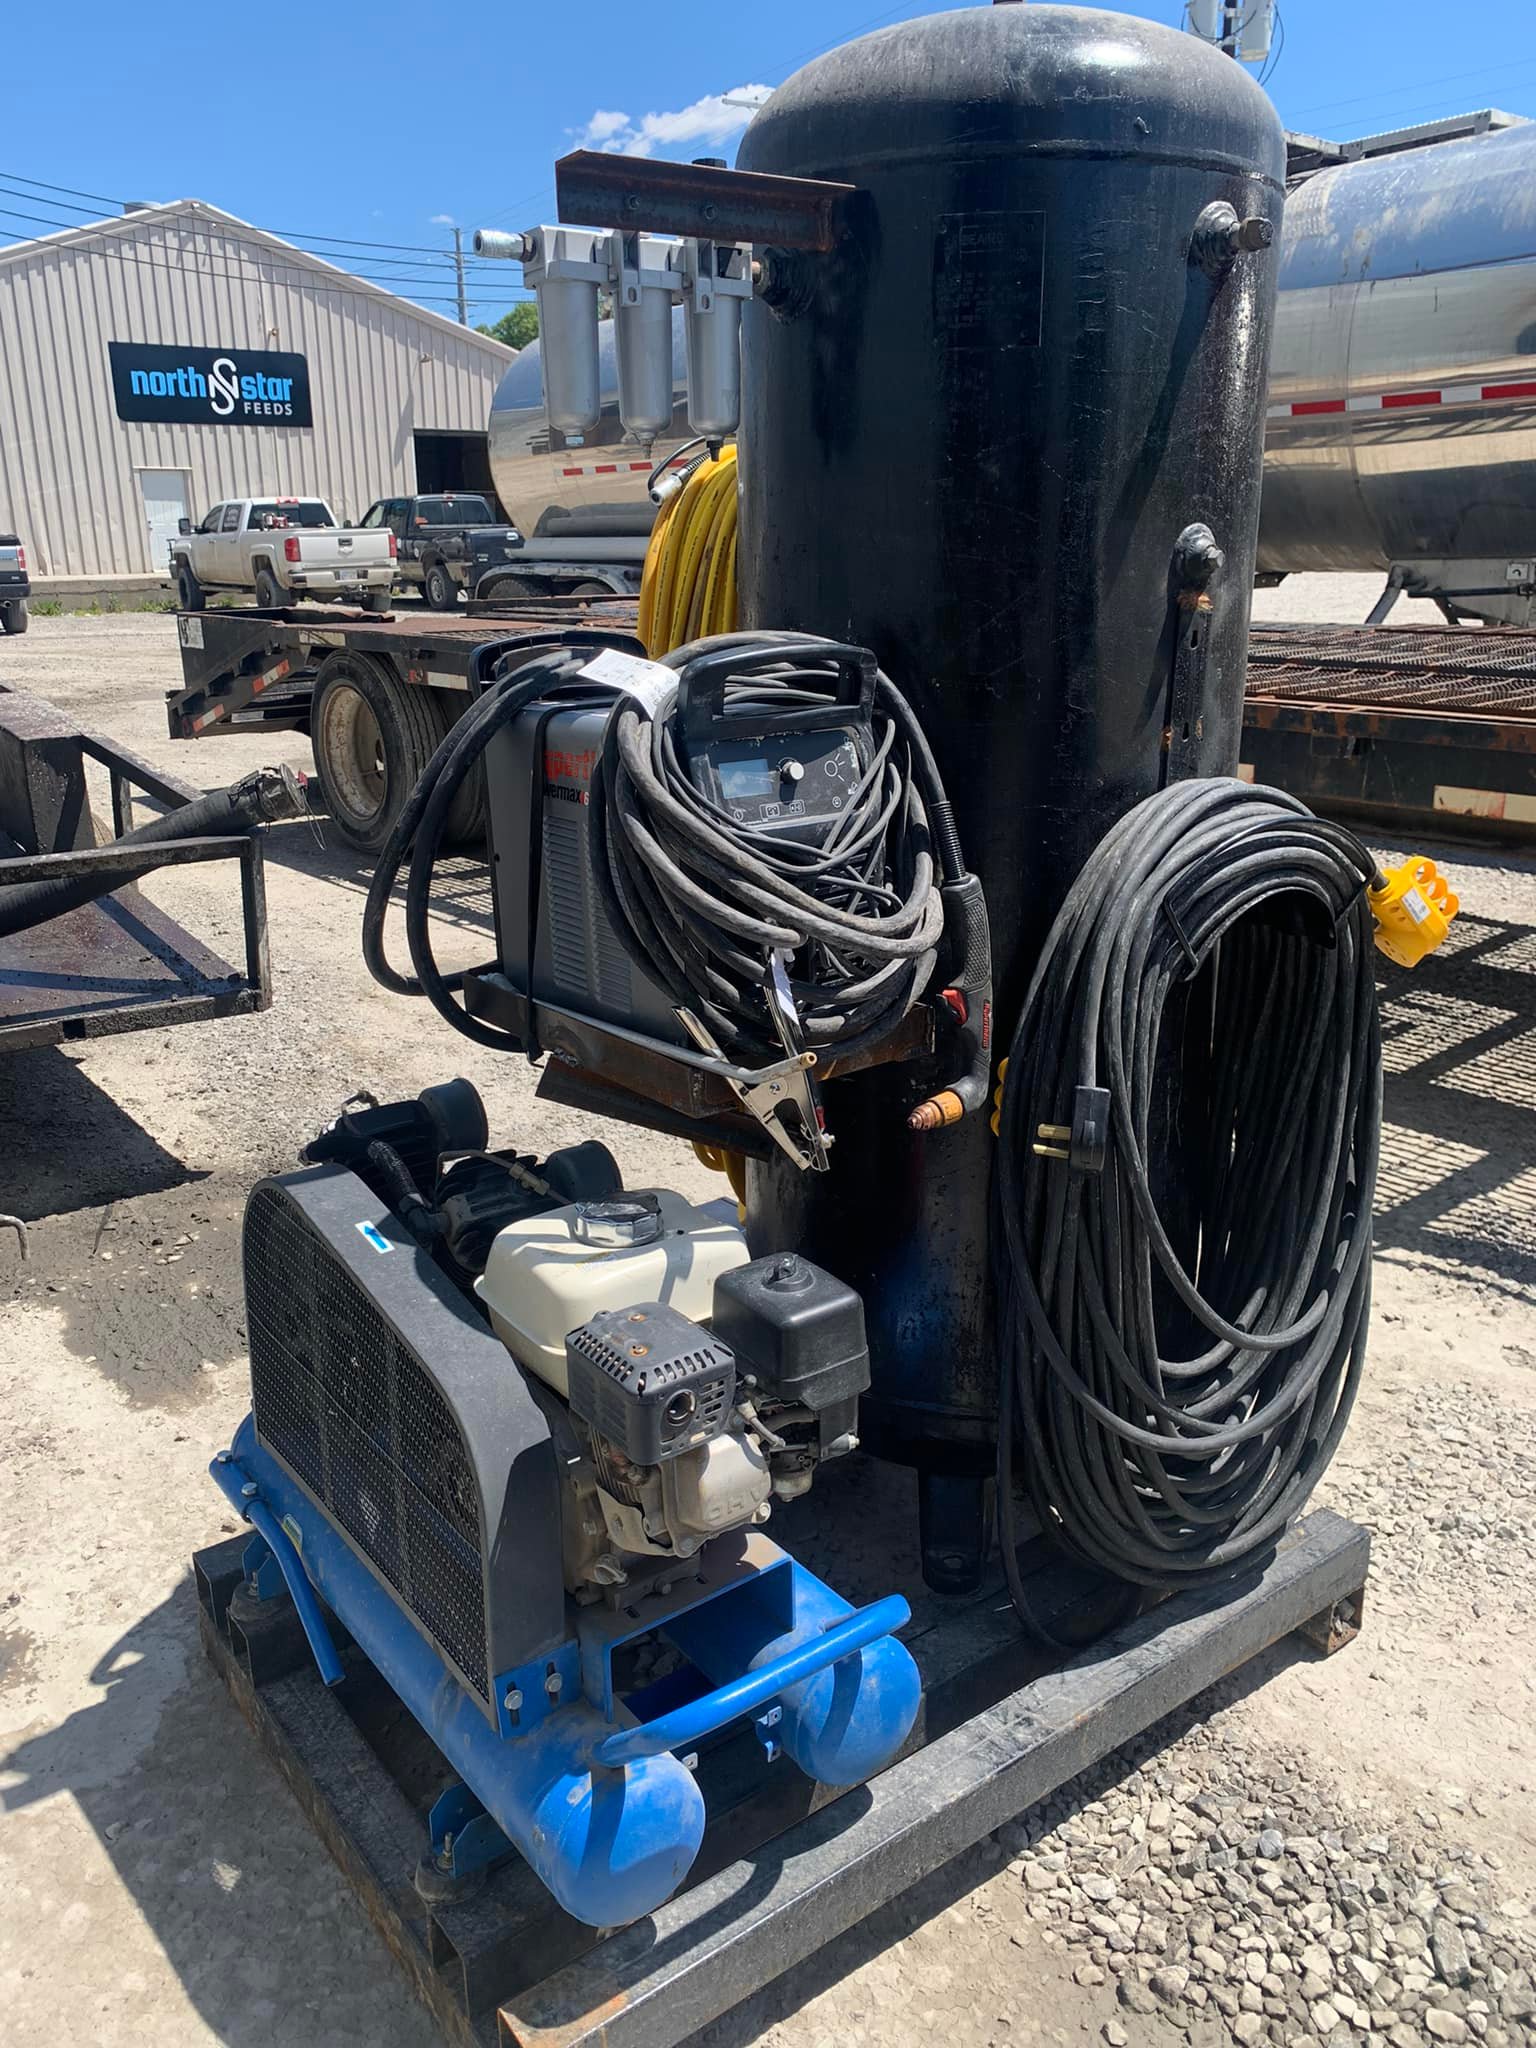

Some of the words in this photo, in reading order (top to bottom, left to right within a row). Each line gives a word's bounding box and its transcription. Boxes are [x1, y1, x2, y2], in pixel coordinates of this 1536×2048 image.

[130, 366, 207, 397] north
[240, 372, 293, 401] star
[244, 401, 293, 416] FEEDS
